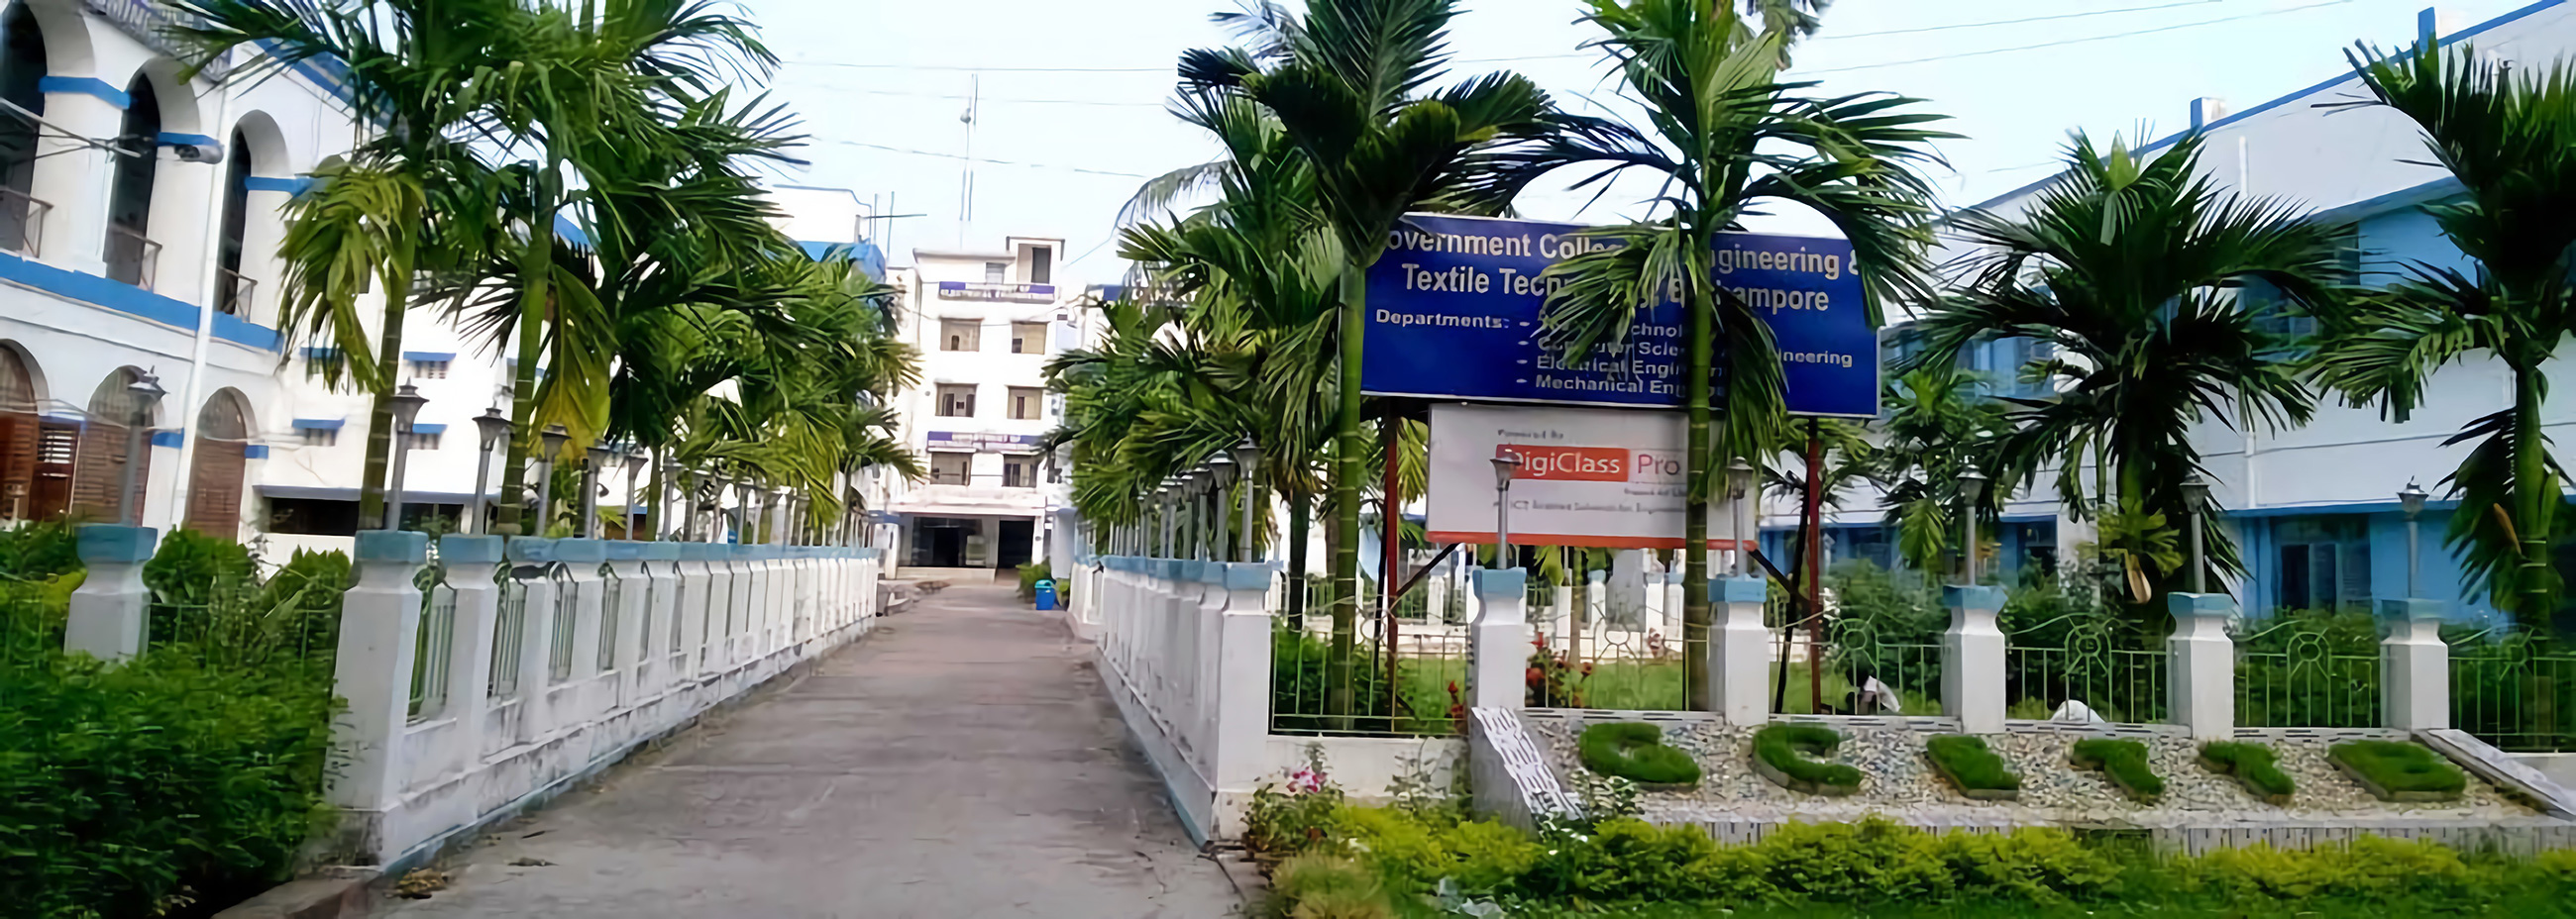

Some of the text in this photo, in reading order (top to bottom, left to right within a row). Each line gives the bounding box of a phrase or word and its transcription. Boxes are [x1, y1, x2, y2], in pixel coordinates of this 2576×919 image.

[1389, 231, 1532, 257] overnment
[1539, 233, 1623, 260] Colle
[1711, 244, 1840, 280] gineering
[1401, 262, 1490, 294] Textile
[1536, 374, 1644, 393] Mechanical
[1638, 454, 1681, 476] Pro
